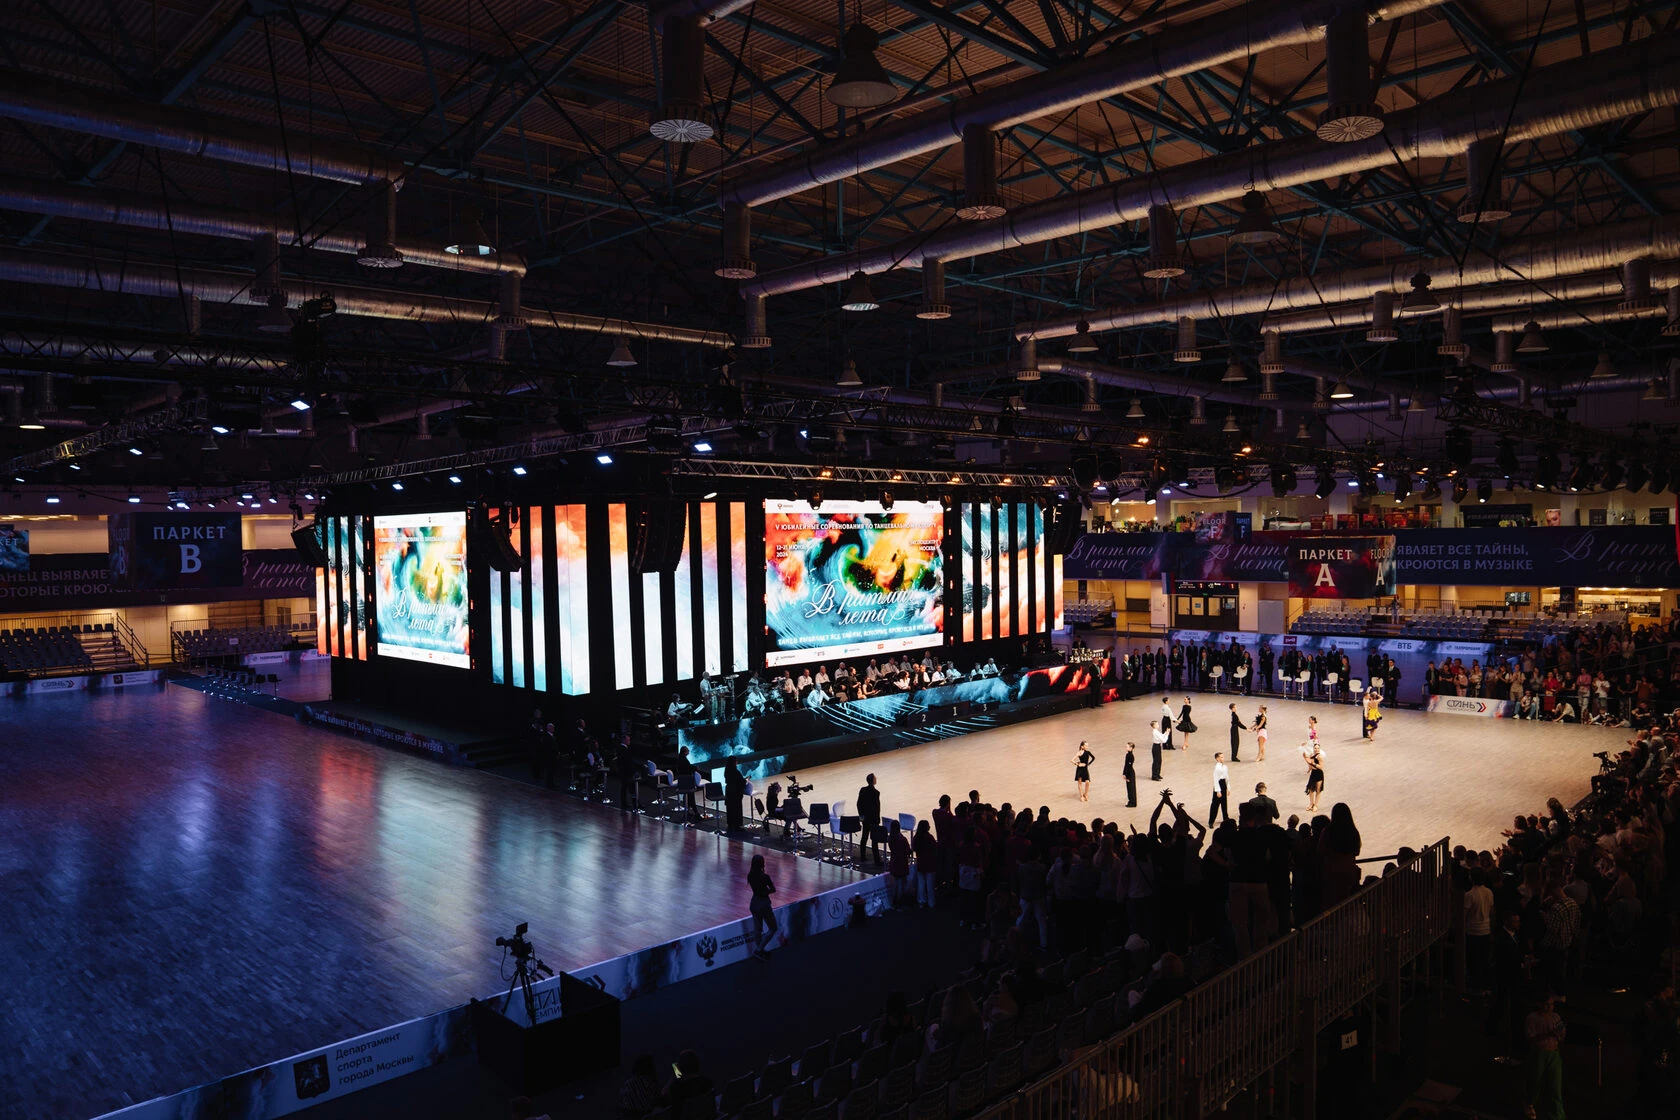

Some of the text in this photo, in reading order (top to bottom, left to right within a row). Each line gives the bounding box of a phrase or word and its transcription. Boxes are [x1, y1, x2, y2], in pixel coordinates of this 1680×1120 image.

[153, 526, 227, 540] ПАРКЕТ
[1300, 548, 1353, 561] ПАРКЕТ
[1447, 544, 1473, 555] ВСЕ
[1474, 541, 1529, 557] ТАЙНЫ,
[1396, 559, 1534, 571] КРОЮТСЯ В МУЗЫКЕ
[41, 568, 110, 582] ВЫЯВЛЯЕ
[1397, 642, 1412, 650] ВТБ
[921, 713, 927, 723] 2
[952, 706, 958, 717] 1
[335, 1032, 401, 1061] Департамент
[336, 1055, 373, 1073] спорта
[338, 1055, 415, 1086] города Москвы
